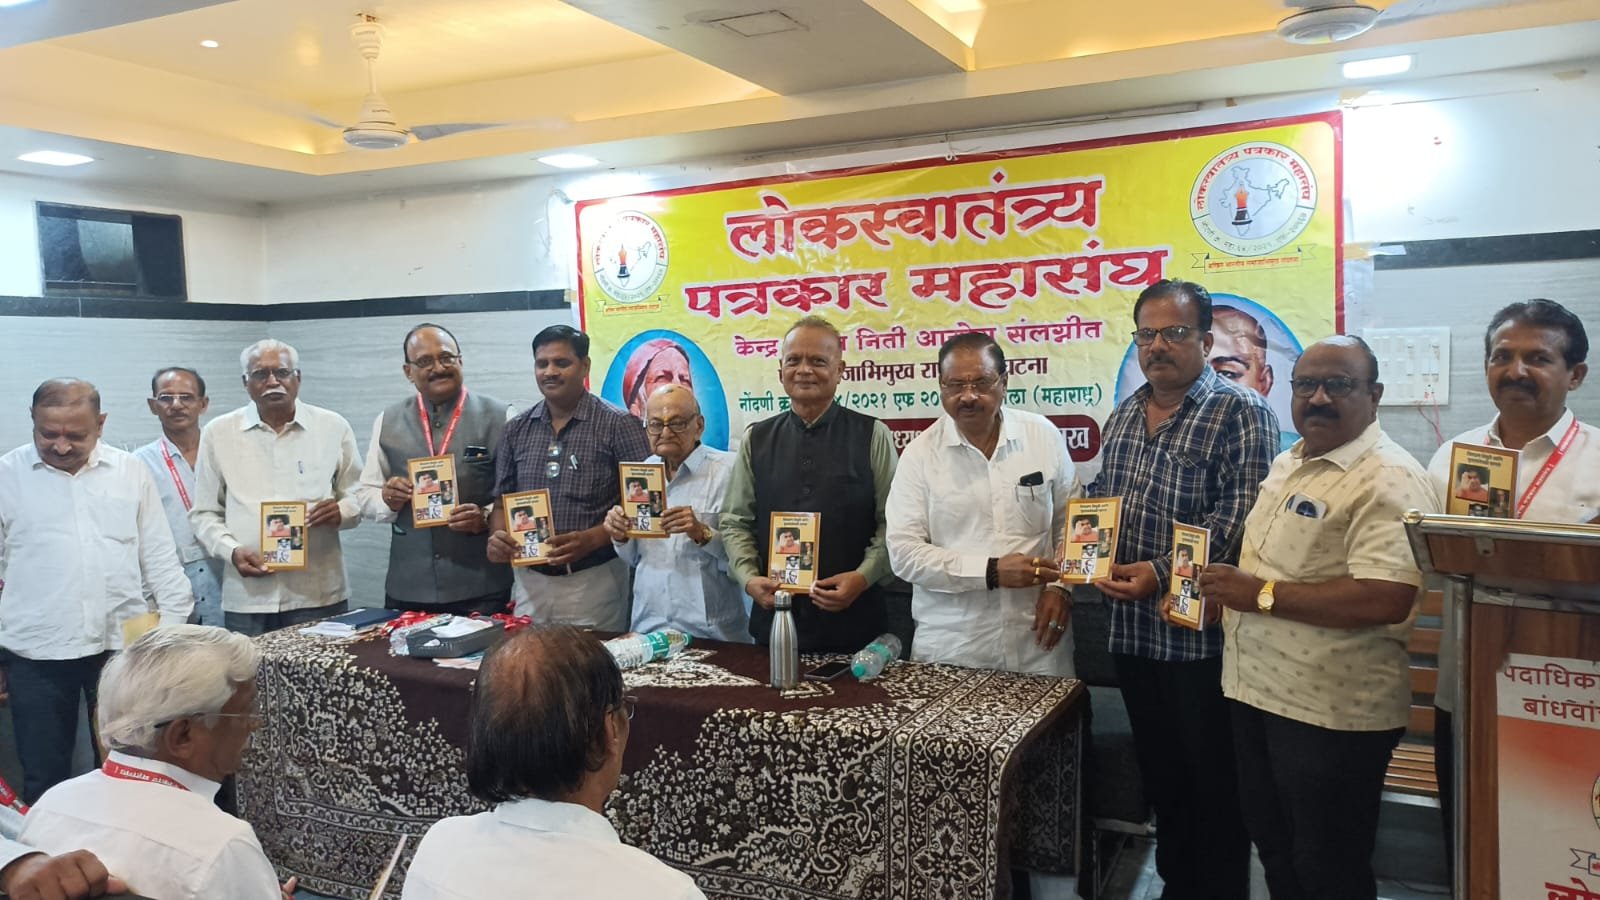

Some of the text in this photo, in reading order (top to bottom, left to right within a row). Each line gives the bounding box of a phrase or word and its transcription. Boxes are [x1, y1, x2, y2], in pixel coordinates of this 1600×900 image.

[726, 171, 1103, 258] लोकस्वातंत्र्य
[684, 271, 888, 319] पत्रकार
[910, 239, 1169, 310] महासंघ
[734, 335, 779, 357] केन्द्र
[856, 325, 907, 351] निती
[841, 359, 915, 386] जाभिमुख
[738, 390, 774, 413] नोंदणी
[893, 391, 916, 411] एफ
[1033, 382, 1103, 408] (महाराष्ट्र)
[1503, 662, 1600, 690] पदाधिक
[1521, 694, 1600, 723] बांधवां
